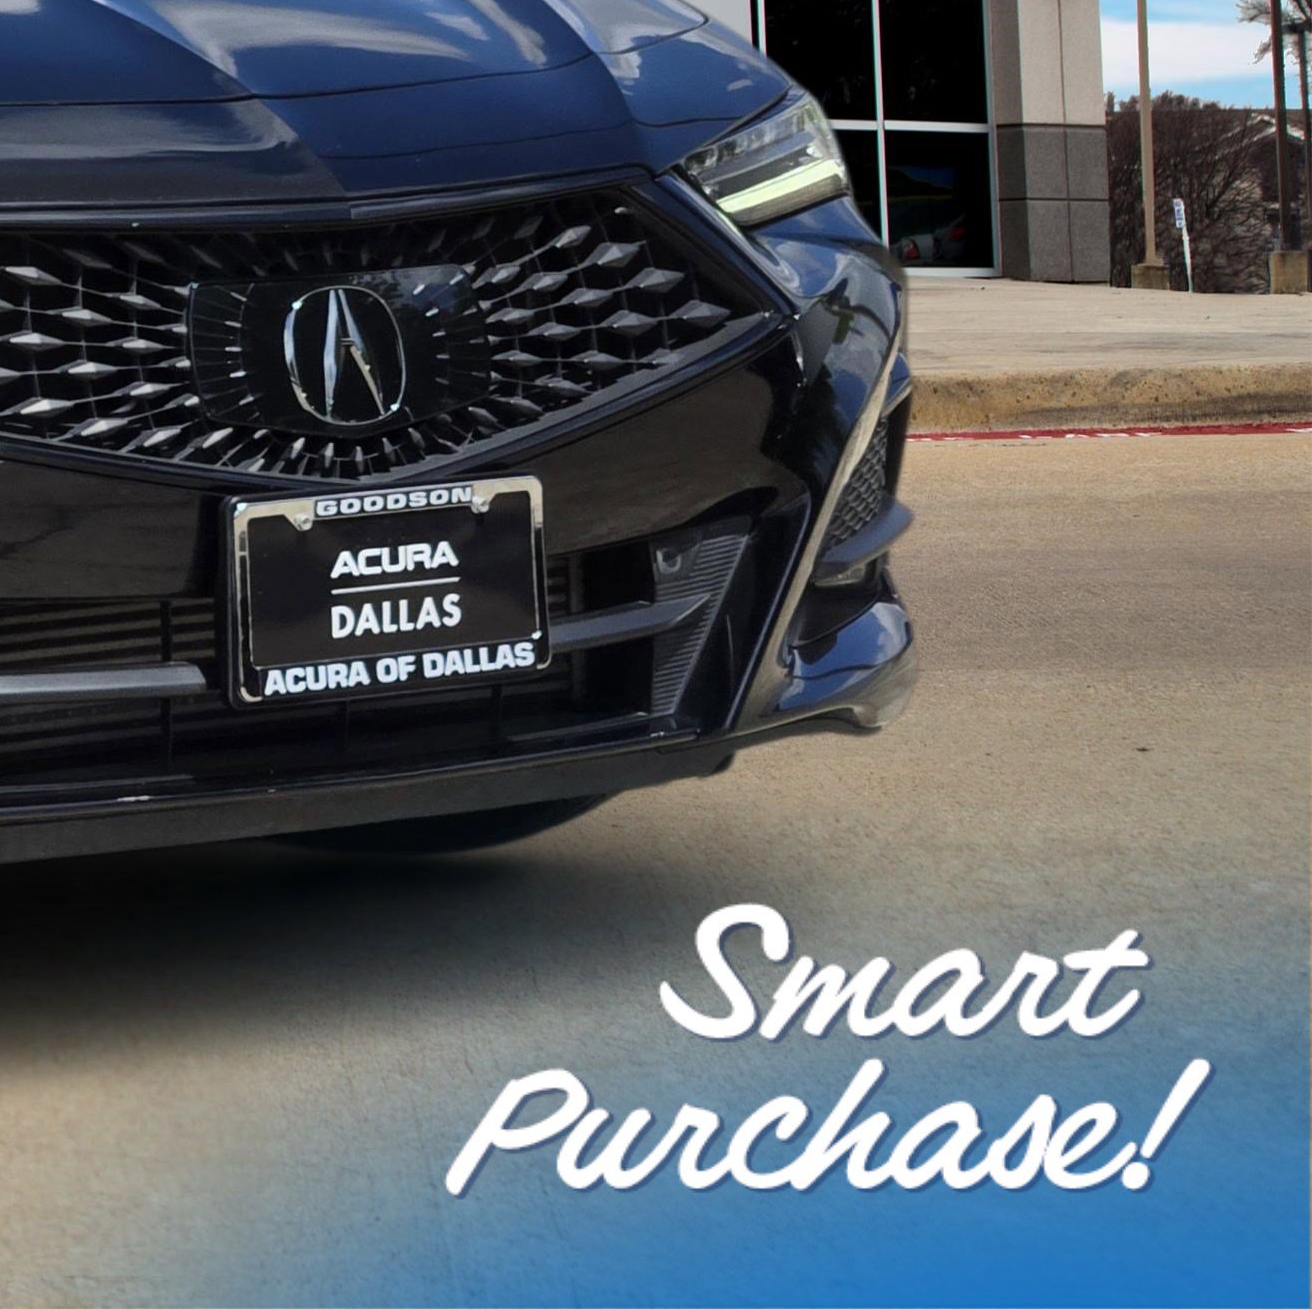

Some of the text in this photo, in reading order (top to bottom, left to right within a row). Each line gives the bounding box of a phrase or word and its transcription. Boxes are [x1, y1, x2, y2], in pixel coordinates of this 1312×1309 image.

[316, 487, 472, 516] GOODSON
[329, 540, 460, 579] ACURA
[330, 593, 463, 640] DALLAS
[264, 641, 536, 696] ACURA OF DALLAS
